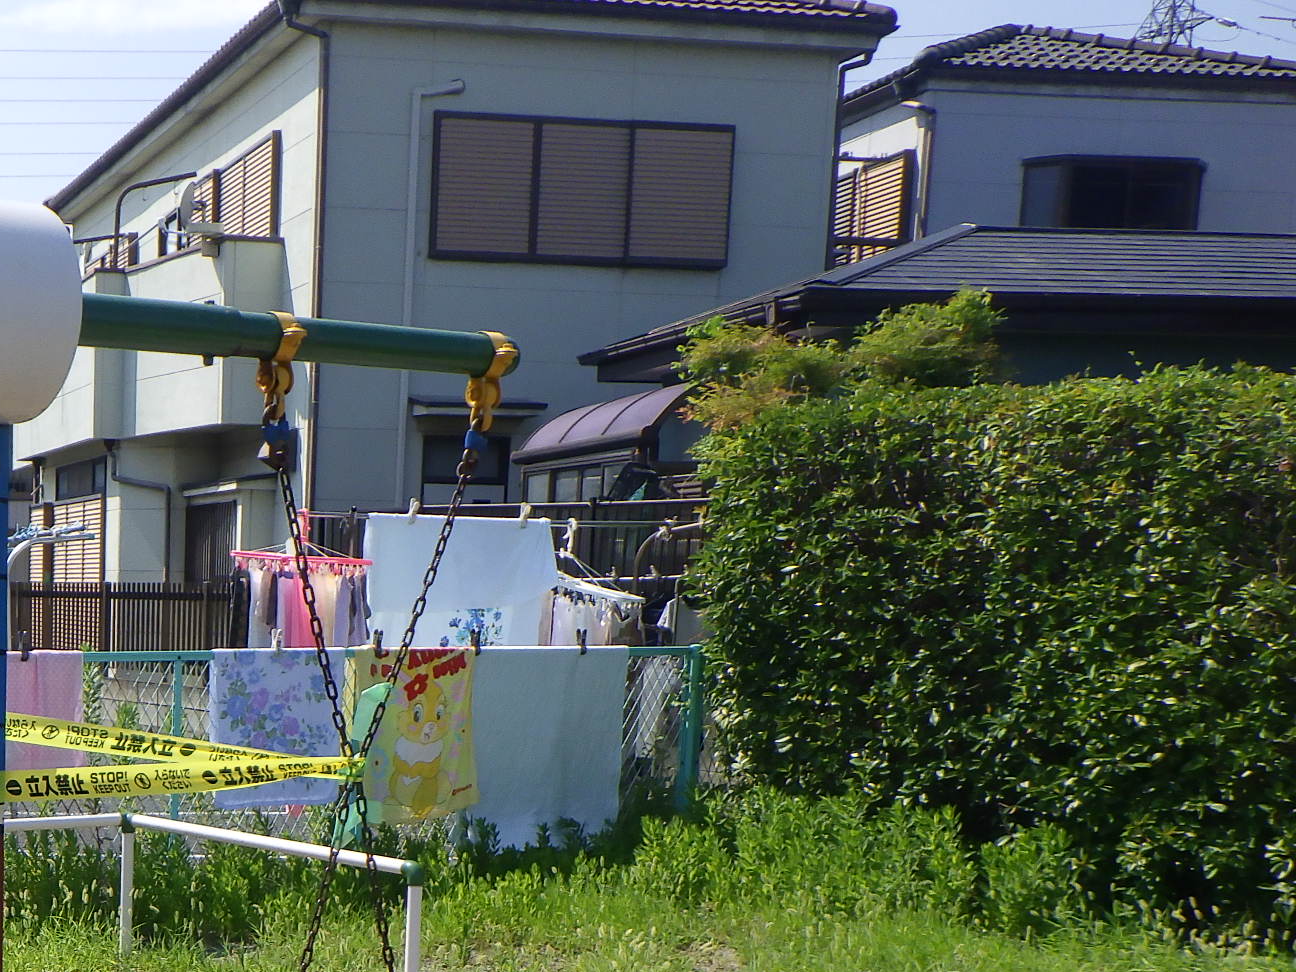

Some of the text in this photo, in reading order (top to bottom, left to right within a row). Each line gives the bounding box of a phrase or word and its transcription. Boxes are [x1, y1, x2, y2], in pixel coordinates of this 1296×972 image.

[90, 771, 128, 784] STOP!
[154, 768, 191, 780] 入らないで
[25, 773, 89, 797] 立入禁止
[161, 780, 192, 790] ください
